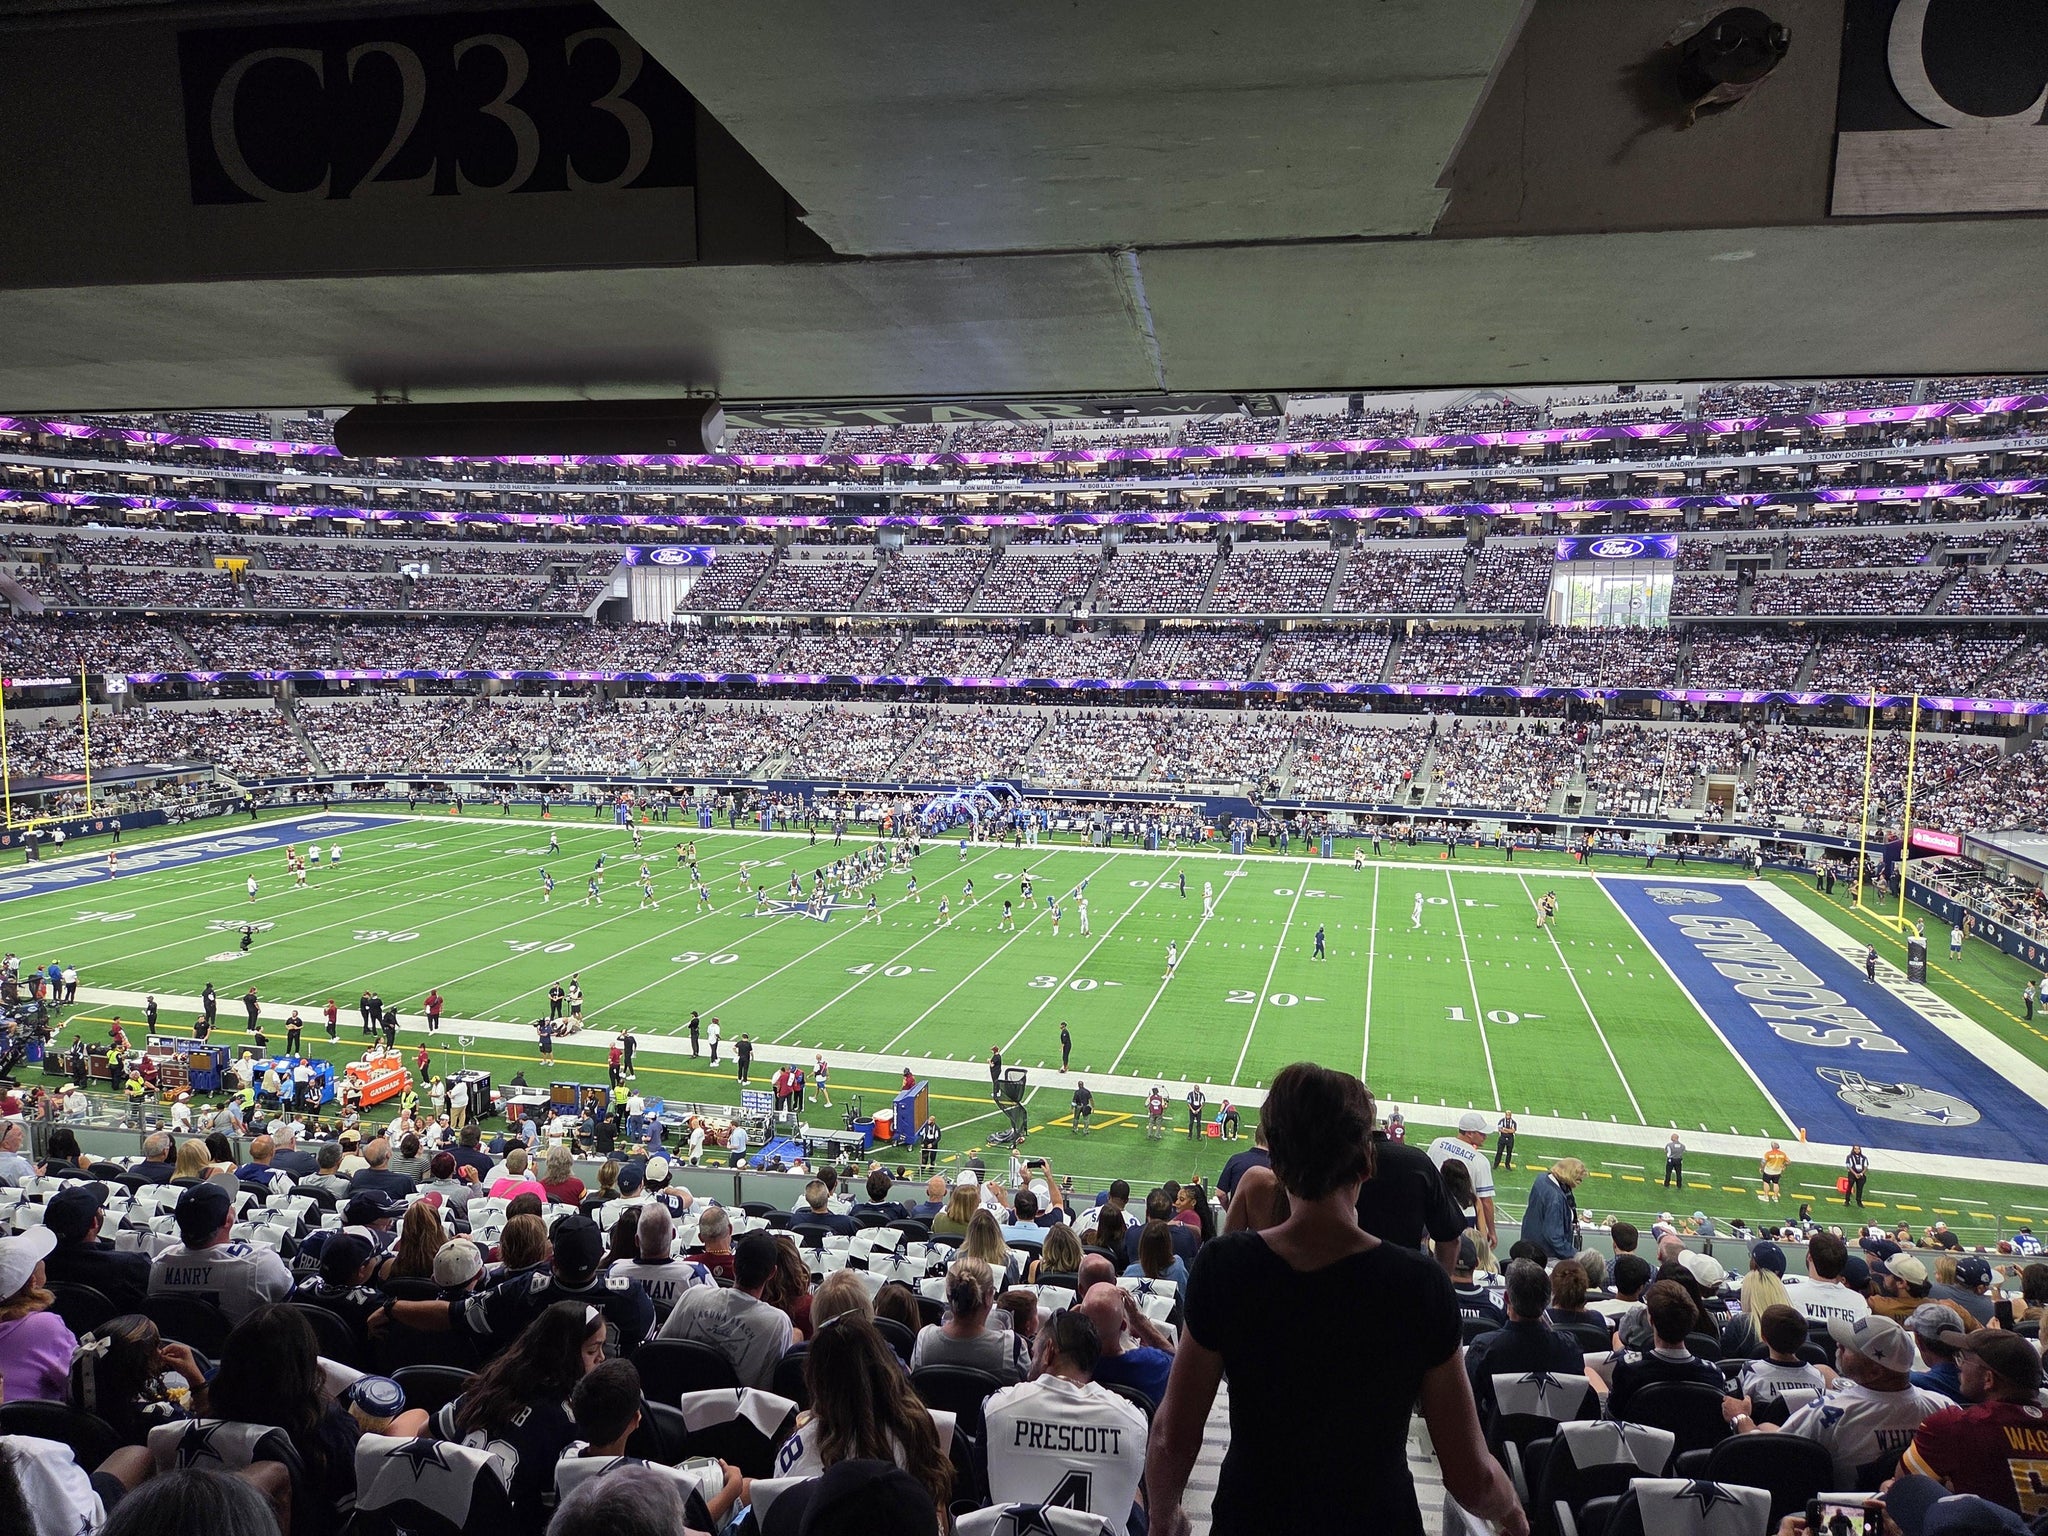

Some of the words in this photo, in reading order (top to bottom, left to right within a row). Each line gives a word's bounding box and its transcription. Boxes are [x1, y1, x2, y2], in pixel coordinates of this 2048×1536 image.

[211, 27, 653, 201] C233
[1845, 450, 1884, 459] DORSETT
[657, 548, 685, 562] Ford
[1598, 539, 1635, 557] Ford
[1922, 834, 1956, 849] Blockchain
[671, 951, 739, 965] 50
[845, 963, 913, 977] 40
[1027, 975, 1099, 991] 30
[1668, 914, 1909, 1054] COWBOYS
[1224, 989, 1300, 1007] 20
[1893, 988, 1963, 1020] LOVE
[1444, 1006, 1520, 1024] 10
[369, 1079, 400, 1097] GATORADE
[1209, 1124, 1219, 1136] 20
[1439, 1141, 1476, 1162] STAUBACH
[164, 1267, 213, 1285] MANRY
[692, 1311, 728, 1323] LAGUNA
[1804, 1302, 1855, 1323] WINTERS
[1014, 1420, 1122, 1455] PRESCOTT
